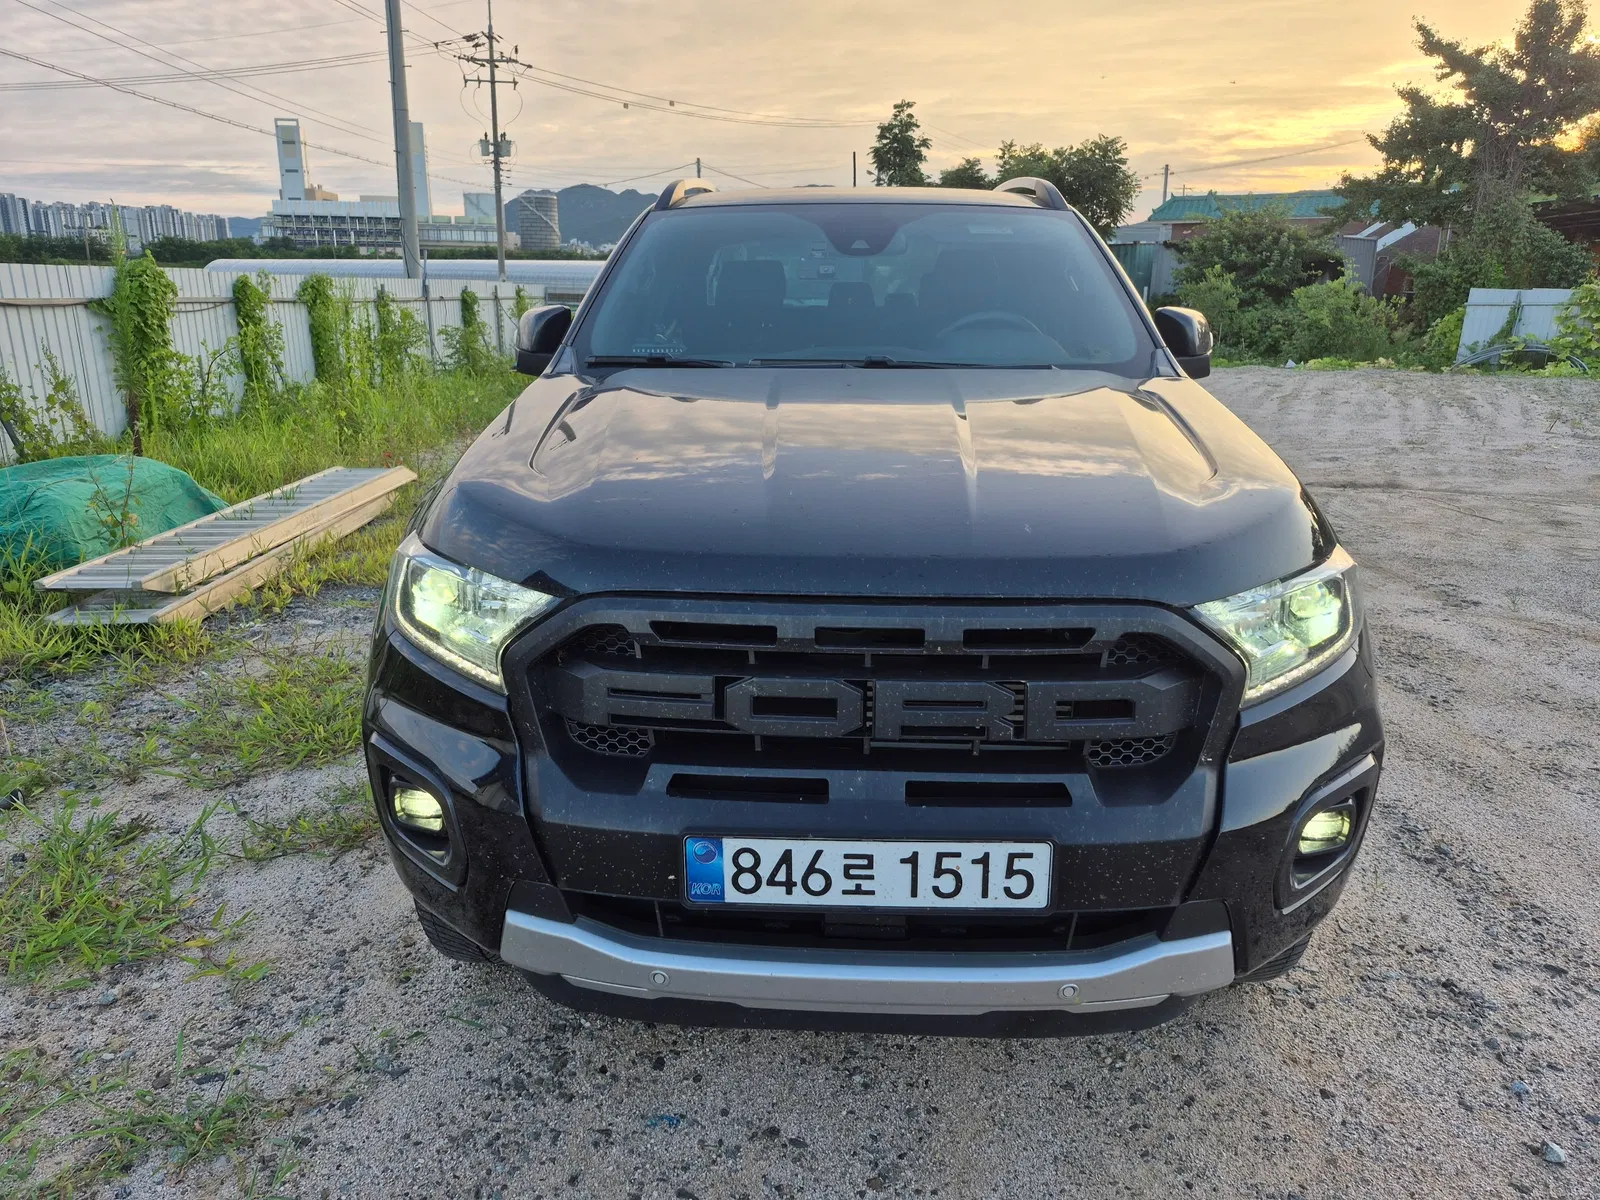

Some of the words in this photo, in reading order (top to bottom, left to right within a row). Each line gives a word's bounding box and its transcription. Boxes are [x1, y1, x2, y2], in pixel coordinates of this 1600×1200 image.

[567, 669, 1181, 742] FORD
[690, 882, 722, 896] KOR
[730, 846, 876, 897] 846로
[899, 850, 1035, 900] 1515
